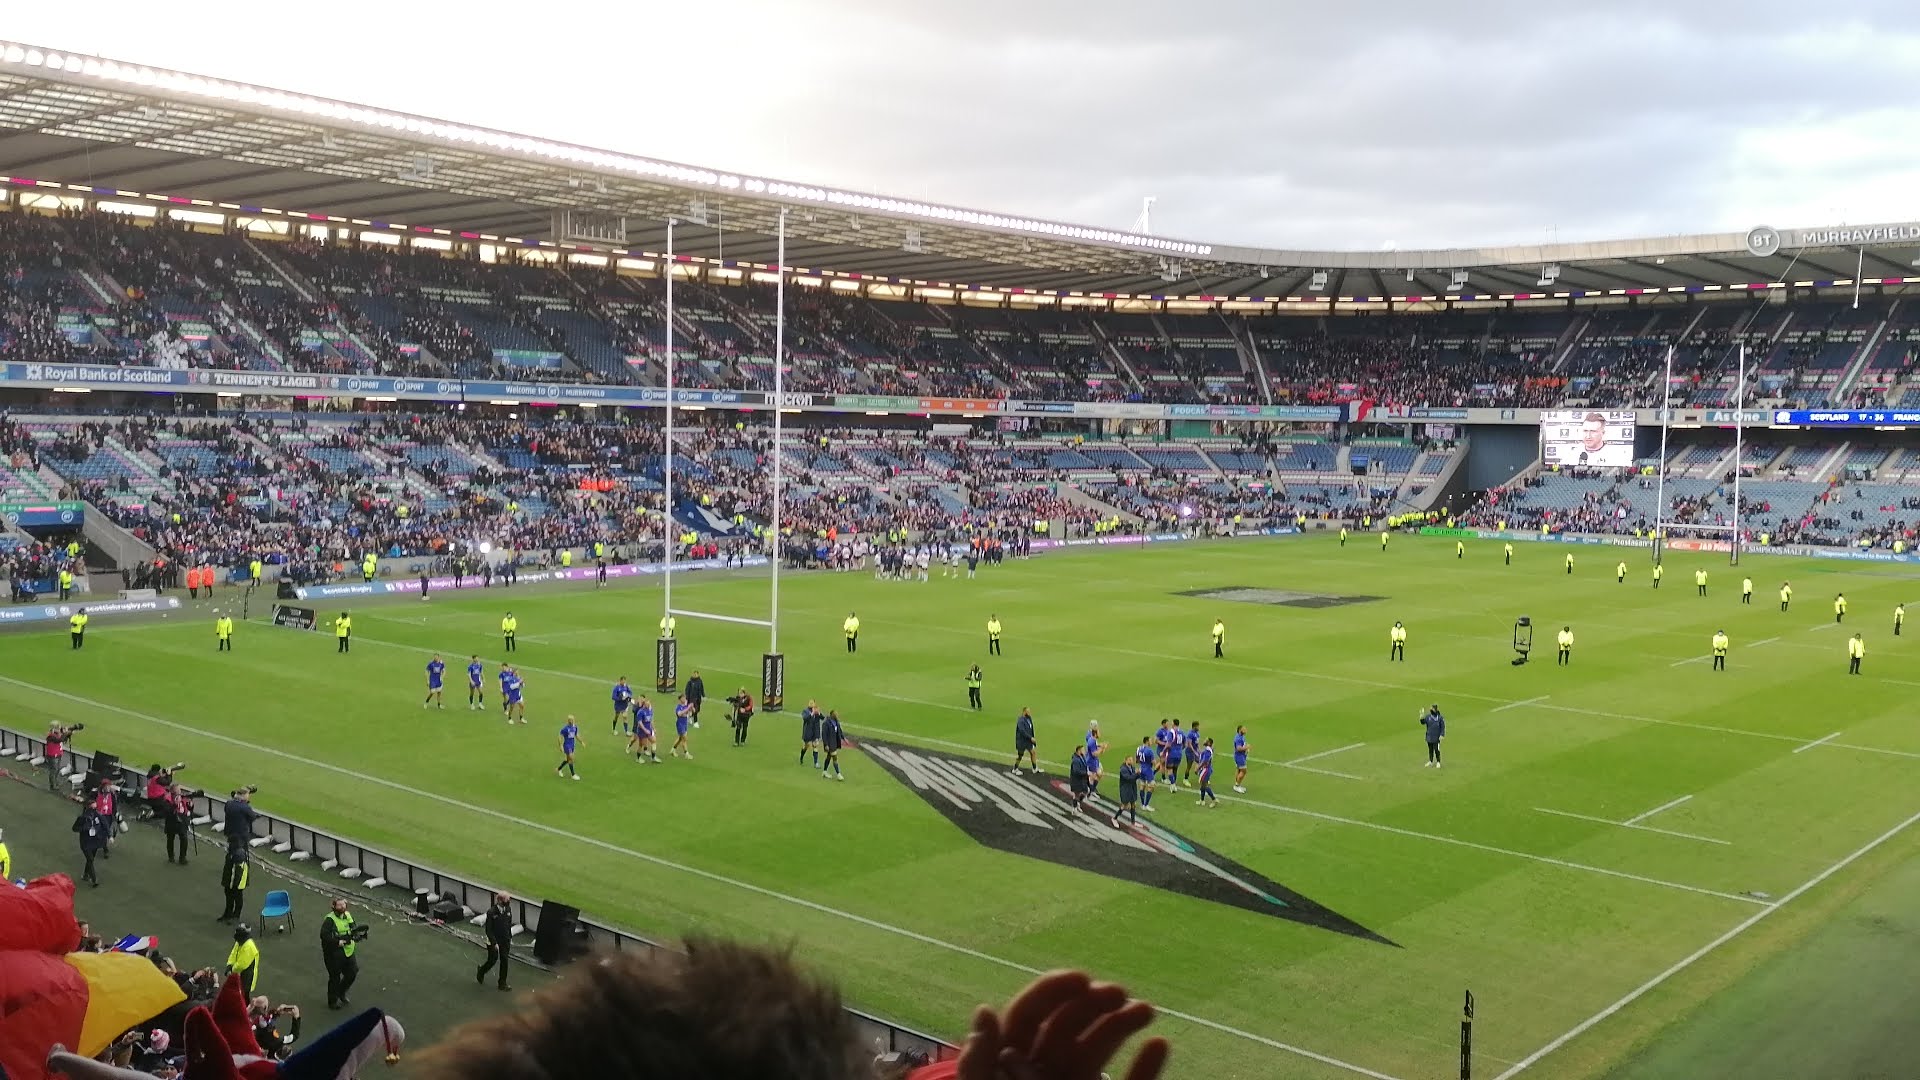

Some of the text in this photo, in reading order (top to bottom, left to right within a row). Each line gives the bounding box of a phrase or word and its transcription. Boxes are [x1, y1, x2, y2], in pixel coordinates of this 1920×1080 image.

[1753, 227, 1920, 247] BT MURRAYFIELD
[45, 366, 171, 383] Royal Bank of Scotland
[214, 373, 279, 386] TENNENT'S
[280, 376, 317, 388] LAGER
[505, 385, 536, 395] Welcome
[538, 386, 545, 395] to
[1713, 411, 1760, 422] As One
[1810, 413, 1849, 421] SCOTLAND
